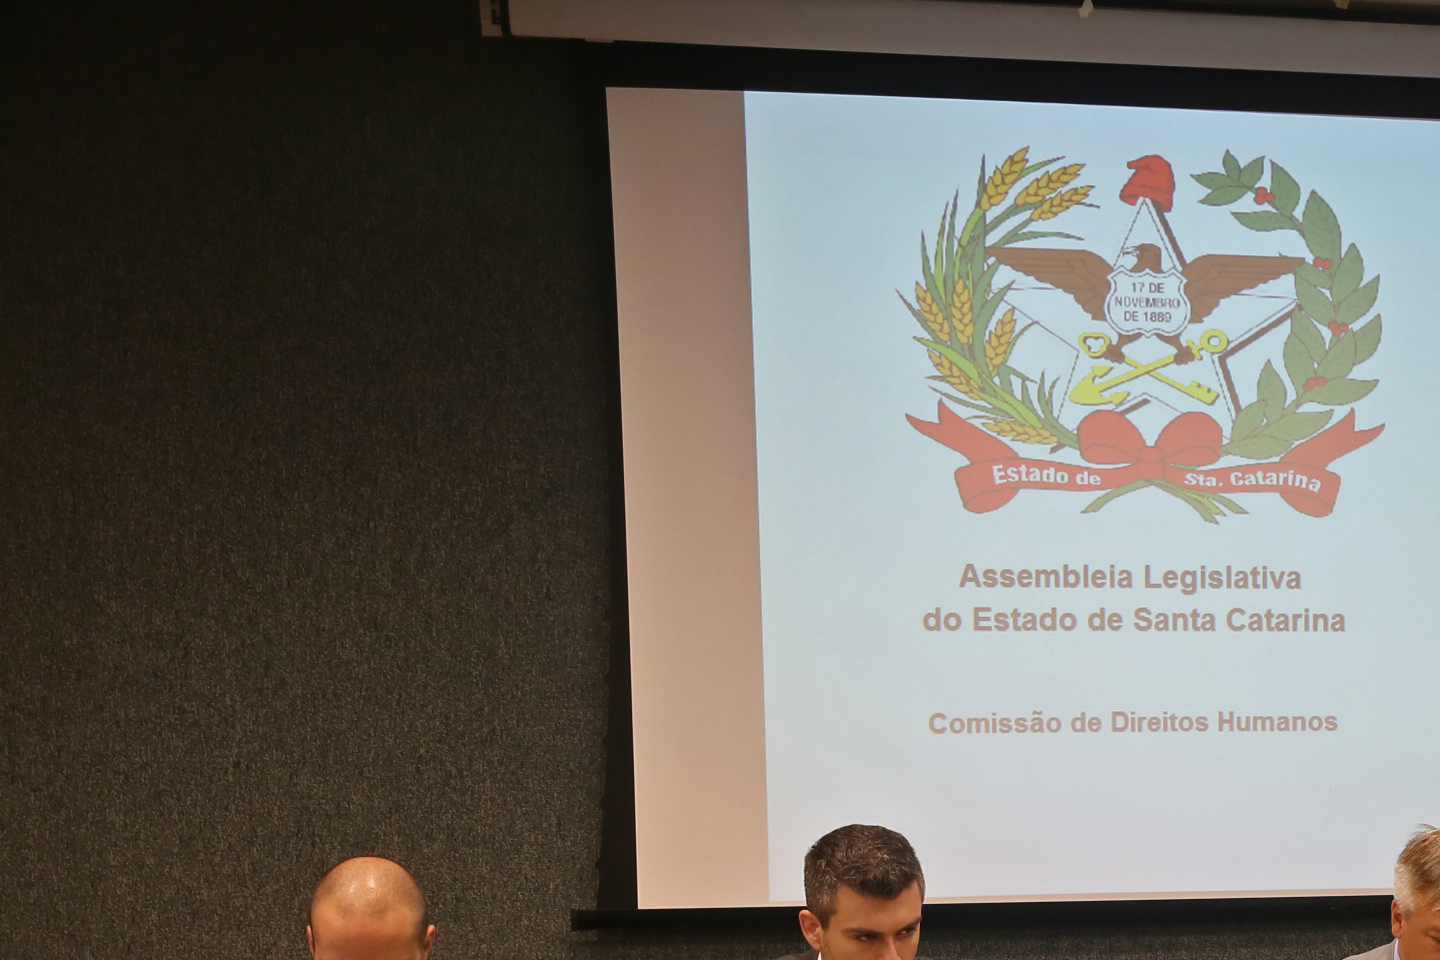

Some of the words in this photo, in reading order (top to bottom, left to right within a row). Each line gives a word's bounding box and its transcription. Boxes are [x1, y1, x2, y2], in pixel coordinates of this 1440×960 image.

[1131, 282, 1145, 293] 17
[1149, 282, 1165, 294] DE
[1115, 296, 1181, 309] NOVEMBRO
[1124, 310, 1139, 322] DE
[1143, 311, 1172, 323] 1889
[992, 464, 1069, 485] Estado
[1076, 470, 1102, 486] de
[1184, 472, 1224, 487] Sta.
[1230, 469, 1322, 493] Catarina
[958, 563, 1133, 589] Assembleia
[1143, 564, 1302, 596] Legislativa
[922, 606, 962, 632] do
[972, 606, 1077, 632] Estado
[1087, 606, 1124, 632] de
[1133, 606, 1216, 633] Santa
[1226, 606, 1346, 633] Catarina
[928, 711, 1062, 735] Comissão
[1070, 711, 1102, 735] de
[1110, 710, 1209, 733] Direitos
[1217, 710, 1339, 733] Humanos
